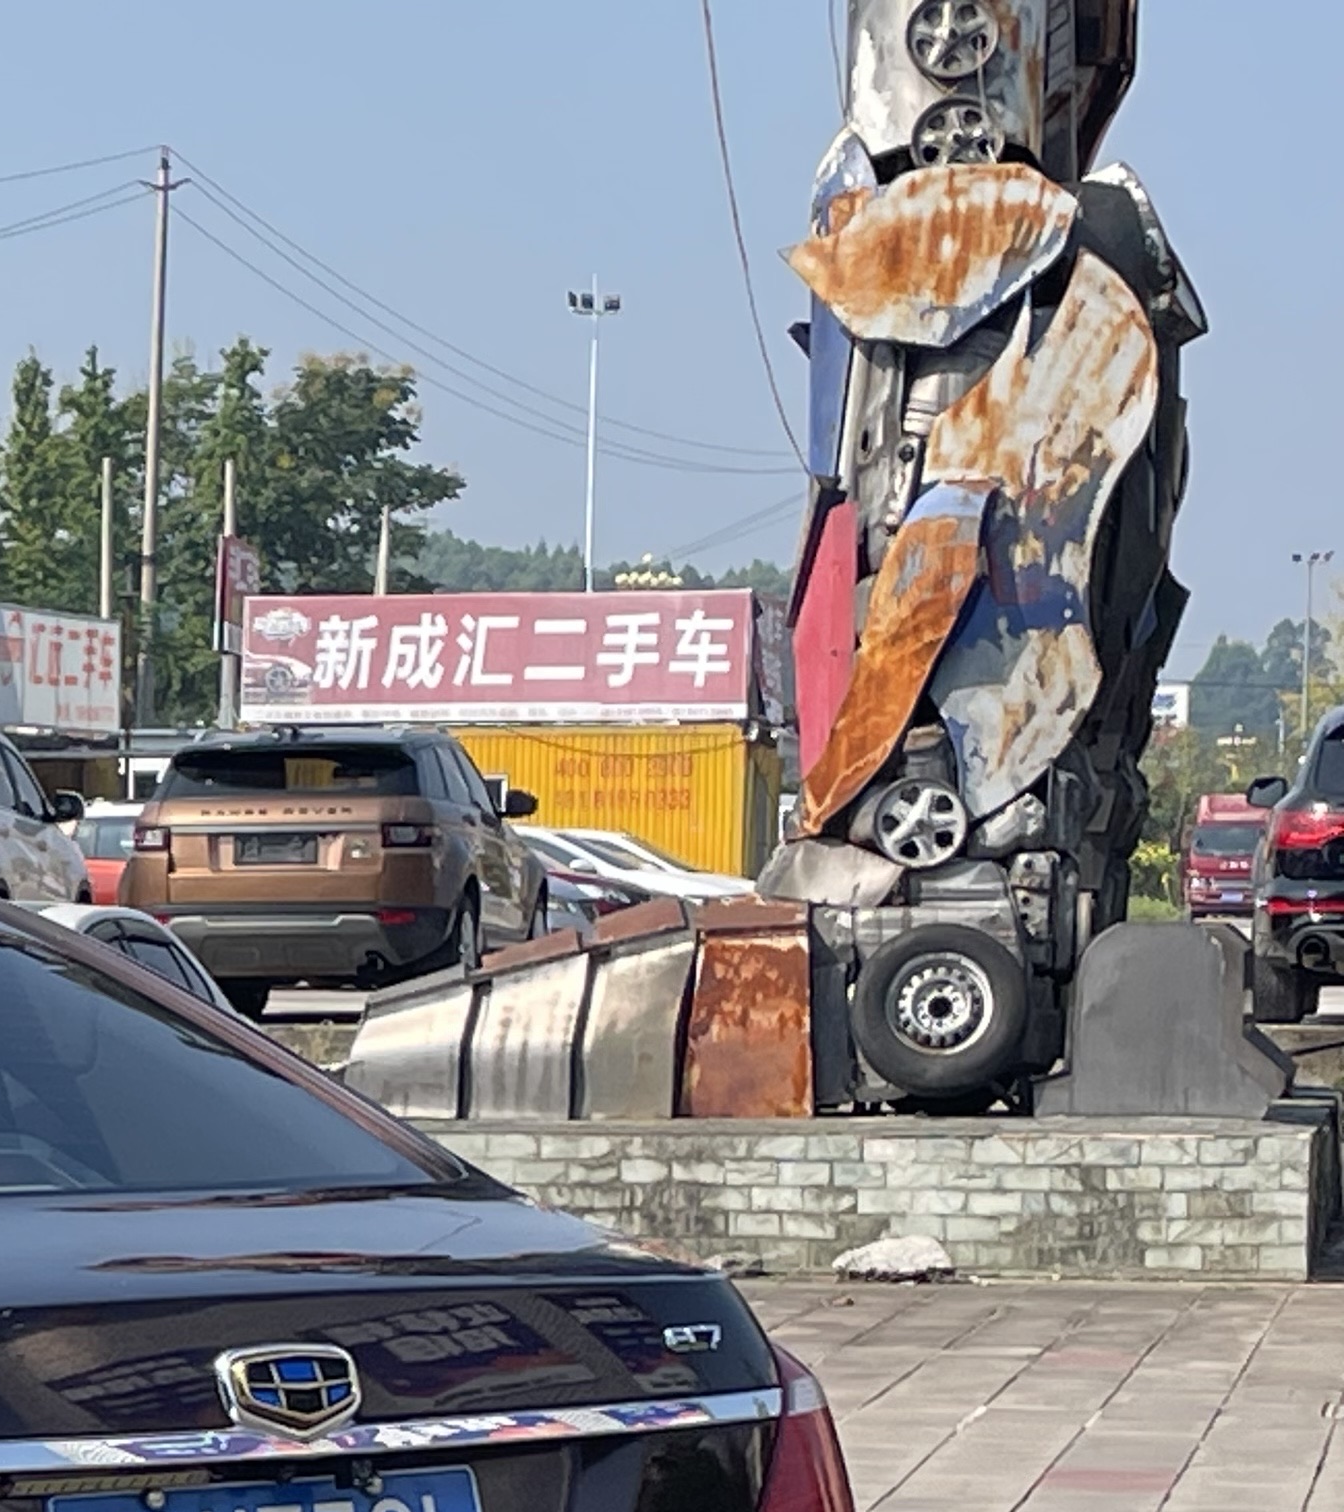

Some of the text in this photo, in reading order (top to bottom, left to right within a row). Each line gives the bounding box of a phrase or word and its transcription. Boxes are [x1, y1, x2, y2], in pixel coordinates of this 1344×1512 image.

[313, 609, 735, 690] 新成汇二手车
